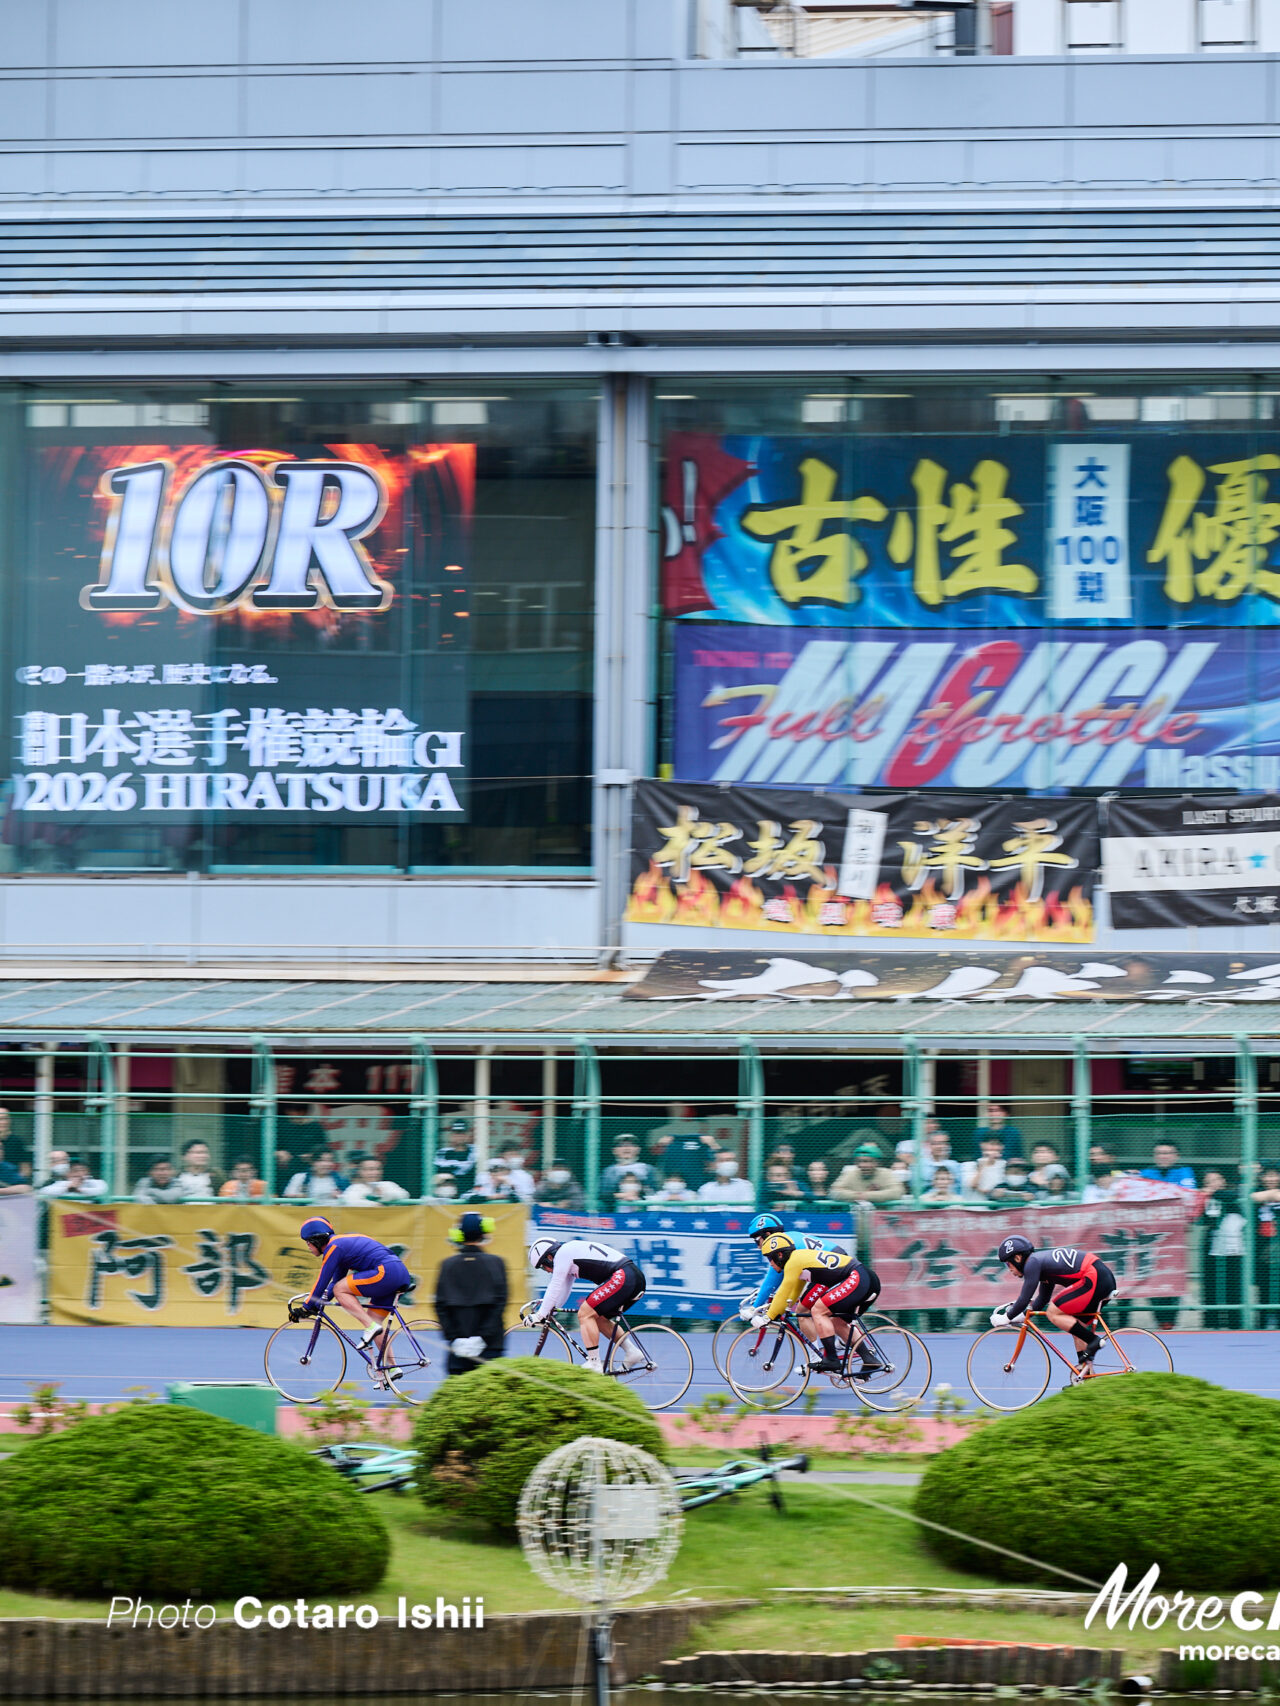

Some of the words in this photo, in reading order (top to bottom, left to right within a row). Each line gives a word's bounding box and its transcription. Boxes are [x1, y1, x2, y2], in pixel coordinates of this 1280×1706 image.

[80, 460, 394, 613] 10R
[741, 457, 1039, 606] 古性
[20, 771, 137, 812] 2026
[140, 771, 465, 812] HIRATSUKA
[655, 805, 835, 893] 松坂
[899, 817, 1080, 904] 洋平
[1133, 846, 1243, 878] AKIRA
[756, 1216, 766, 1229] 4
[589, 1242, 610, 1258] 1
[769, 1236, 779, 1249] 5
[803, 1236, 825, 1251] 4
[1003, 1239, 1014, 1254] 2
[815, 1251, 841, 1270] 5
[1051, 1246, 1078, 1269] 2
[88, 1229, 271, 1316] 阿部
